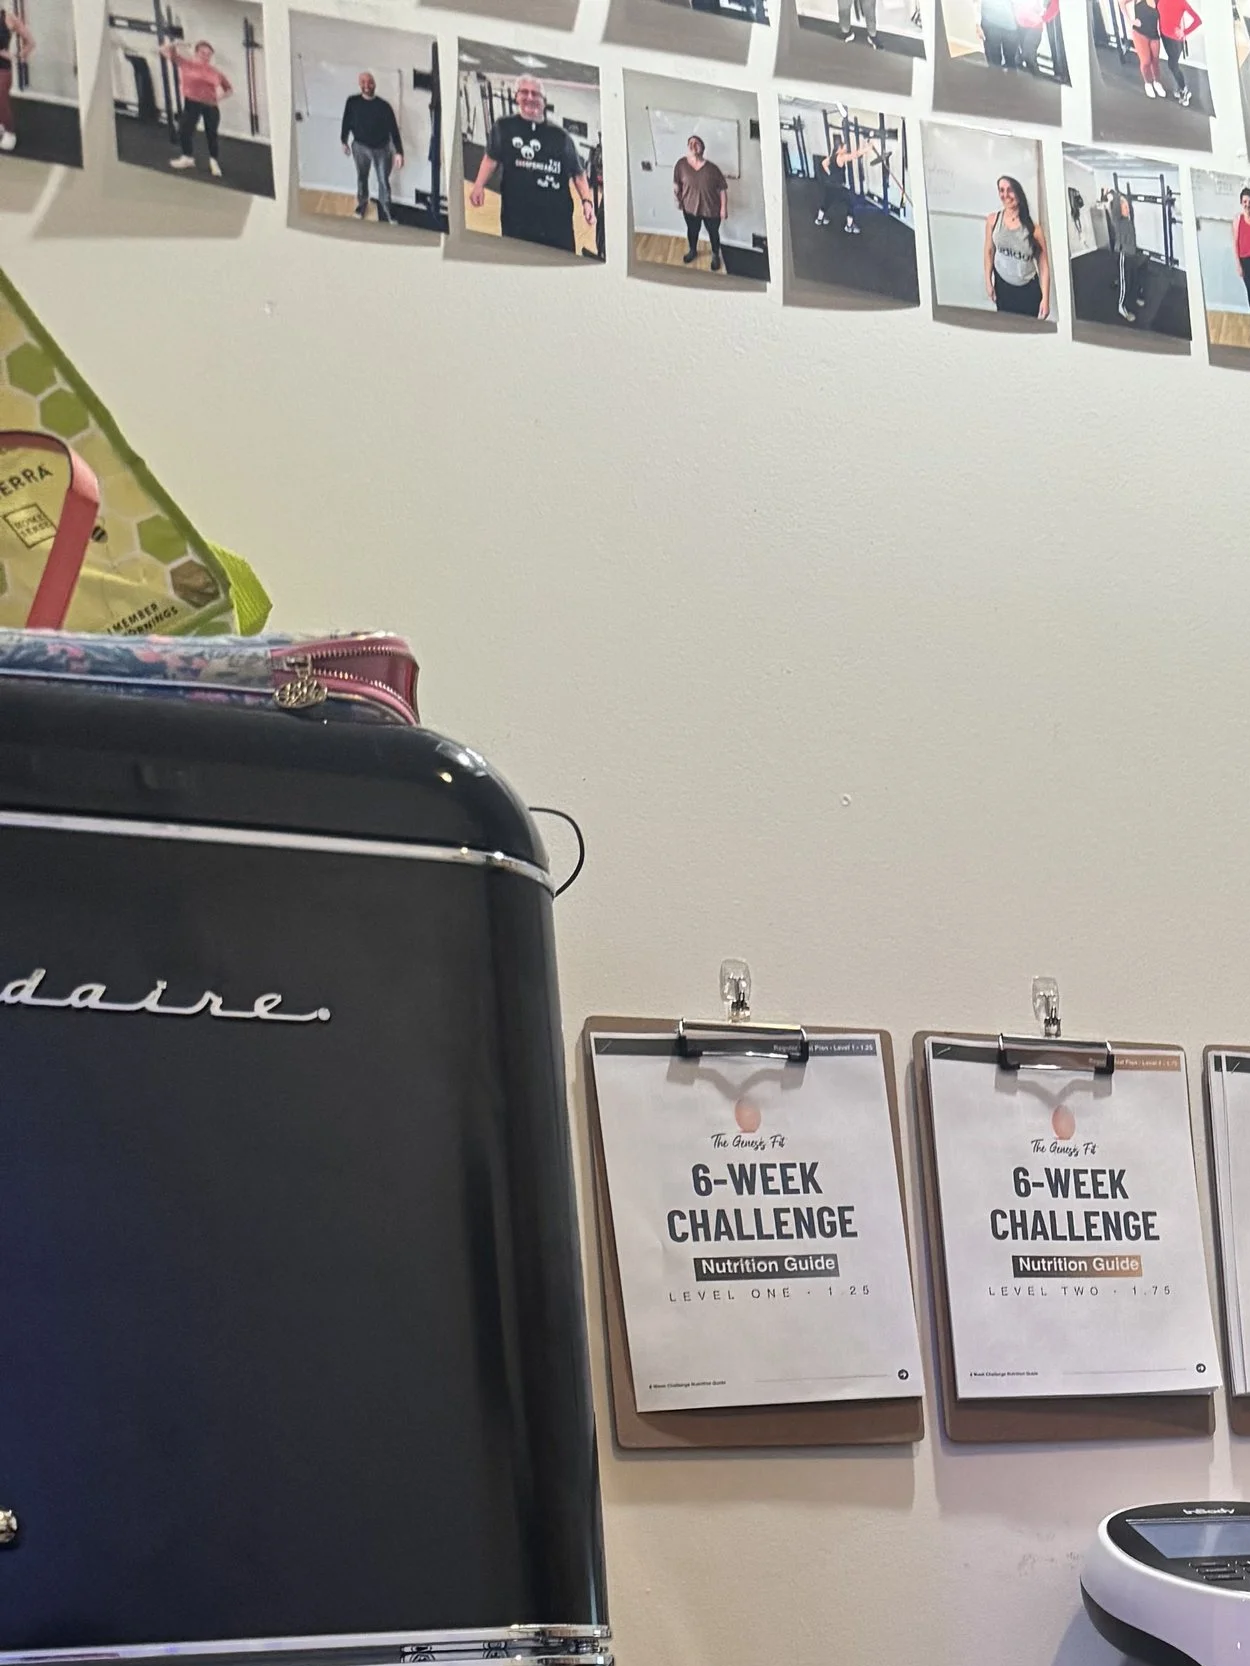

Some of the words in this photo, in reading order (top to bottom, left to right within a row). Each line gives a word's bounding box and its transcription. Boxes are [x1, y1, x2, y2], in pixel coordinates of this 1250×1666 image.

[124, 606, 178, 636] ORNINGS
[711, 1133, 729, 1149] The
[771, 1134, 785, 1149] Fit
[1031, 1139, 1046, 1154] The
[1083, 1142, 1097, 1155] Fit
[692, 1162, 823, 1196] 6-WEEK
[1013, 1166, 1129, 1199] 6-WEEK
[667, 1206, 858, 1243] CHALLENGE
[990, 1208, 1160, 1241] CHALLENGE
[702, 1258, 778, 1274] Nutrition
[784, 1255, 835, 1271] Guide
[1019, 1256, 1087, 1272] Nutrition
[1092, 1257, 1139, 1272] Guide
[669, 1291, 734, 1302] LEVEL
[751, 1288, 790, 1299] ONE
[989, 1286, 1047, 1296] LEVEL
[1062, 1286, 1098, 1296] TWO
